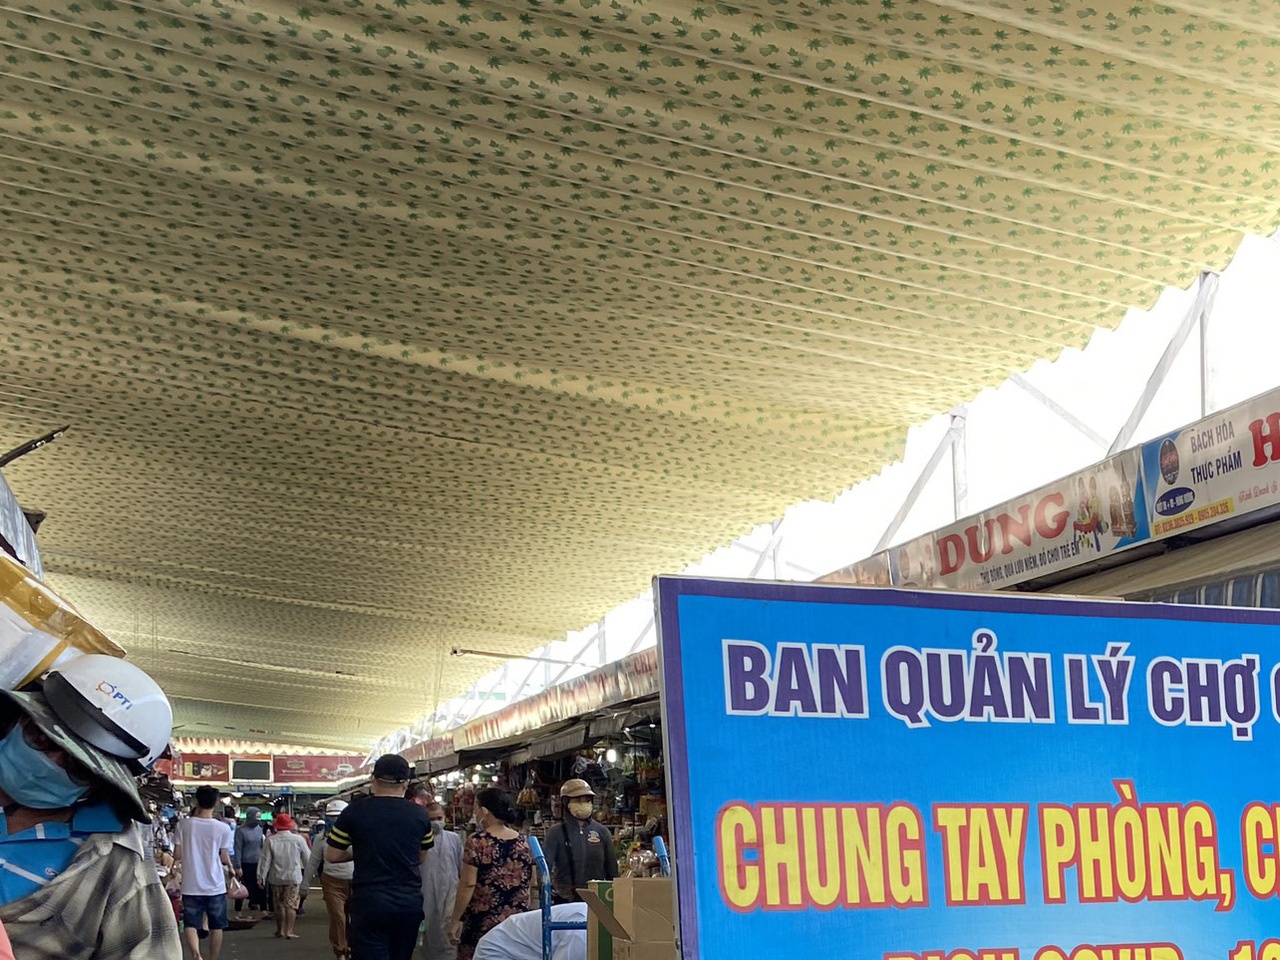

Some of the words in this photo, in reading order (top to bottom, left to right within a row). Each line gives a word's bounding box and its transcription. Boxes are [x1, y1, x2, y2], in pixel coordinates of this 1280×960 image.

[1190, 428, 1215, 453] BÁCH
[1215, 418, 1235, 443] HÓA
[1190, 461, 1214, 485] THỰC
[1216, 445, 1243, 476] PHẨM
[935, 491, 1071, 577] DUNG
[113, 692, 133, 710] PTI
[726, 640, 868, 718] BAN
[882, 628, 1054, 729] QUẢN
[1066, 642, 1134, 724] LÝ
[1148, 654, 1260, 740] CHỢ
[717, 802, 928, 911] CHUNG
[933, 802, 1026, 906] TAY
[1039, 778, 1236, 911] PHÒNG,
